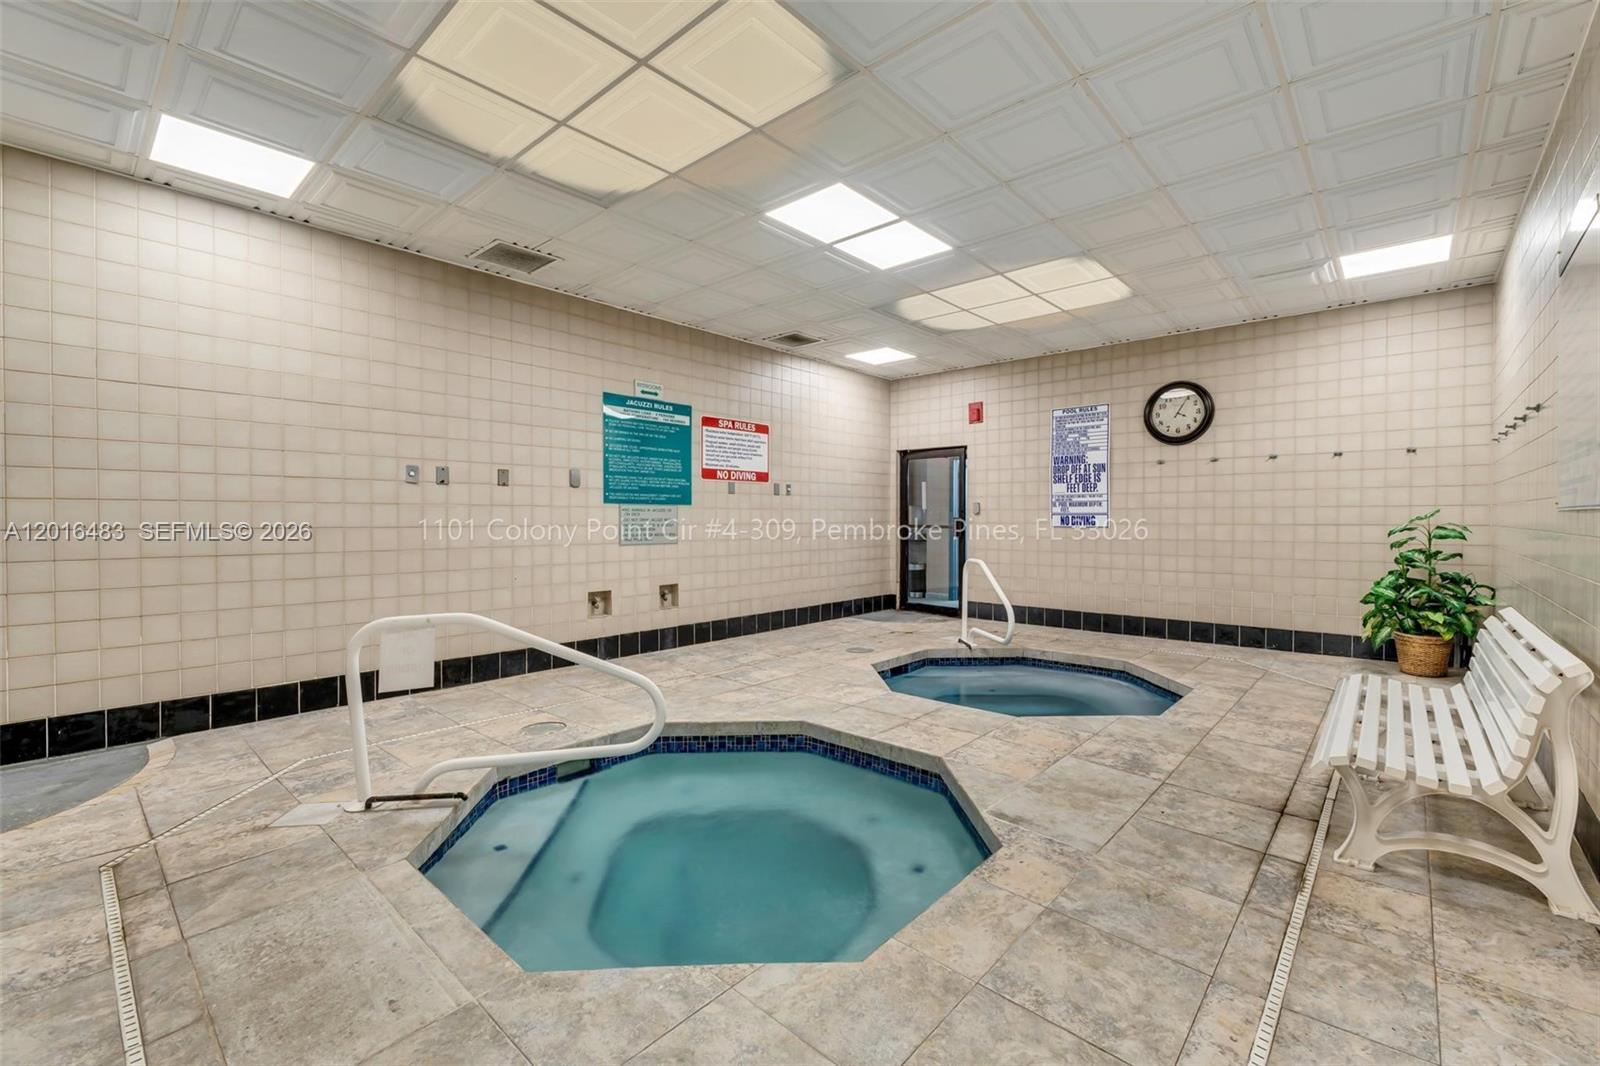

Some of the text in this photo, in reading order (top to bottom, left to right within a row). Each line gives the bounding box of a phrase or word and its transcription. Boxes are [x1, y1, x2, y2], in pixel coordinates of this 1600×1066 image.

[626, 399, 673, 412] JACUZZI RULES
[718, 420, 756, 431] SPA RULES
[1053, 455, 1088, 465] WARNING:
[1053, 463, 1106, 474] DROP OFF AT SUN
[716, 470, 756, 480] NO DIVING
[1053, 473, 1101, 484] SHELF EDGE IS
[1067, 483, 1098, 492] FEET DEEP.
[1060, 515, 1070, 526] NO
